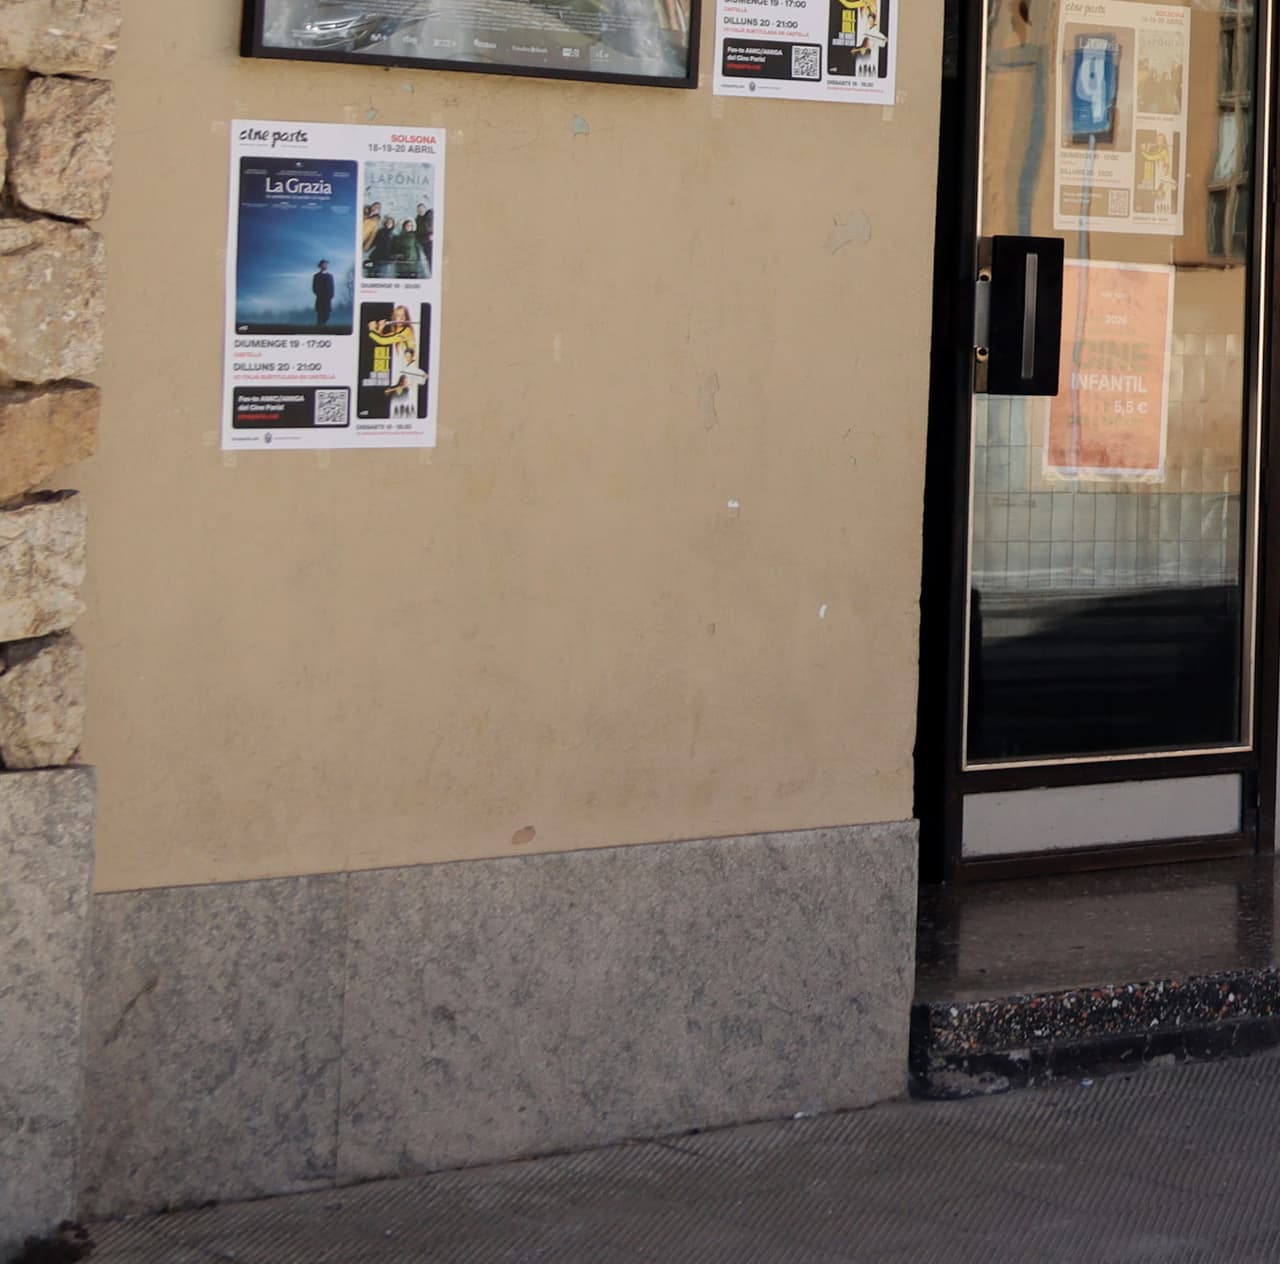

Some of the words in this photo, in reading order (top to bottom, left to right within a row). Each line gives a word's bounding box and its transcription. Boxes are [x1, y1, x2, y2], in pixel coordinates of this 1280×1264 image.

[785, 0, 807, 9] 17:00
[723, 16, 758, 27] DILLUNS
[759, 19, 770, 27] 20
[776, 19, 798, 29] 21:00
[391, 134, 437, 144] SOLSONA
[407, 144, 436, 154] ABRIL
[265, 177, 284, 193] La
[285, 178, 332, 195] Grazia
[234, 339, 288, 348] DIUMENGE
[289, 339, 300, 348] 19
[306, 339, 332, 348] 17:00
[233, 362, 275, 371] DILLUNS
[277, 362, 290, 371] 20
[296, 362, 322, 371] 21:00
[1071, 372, 1148, 394] INFANTIL
[1114, 399, 1135, 416] 5,5
[1137, 401, 1148, 414] €
